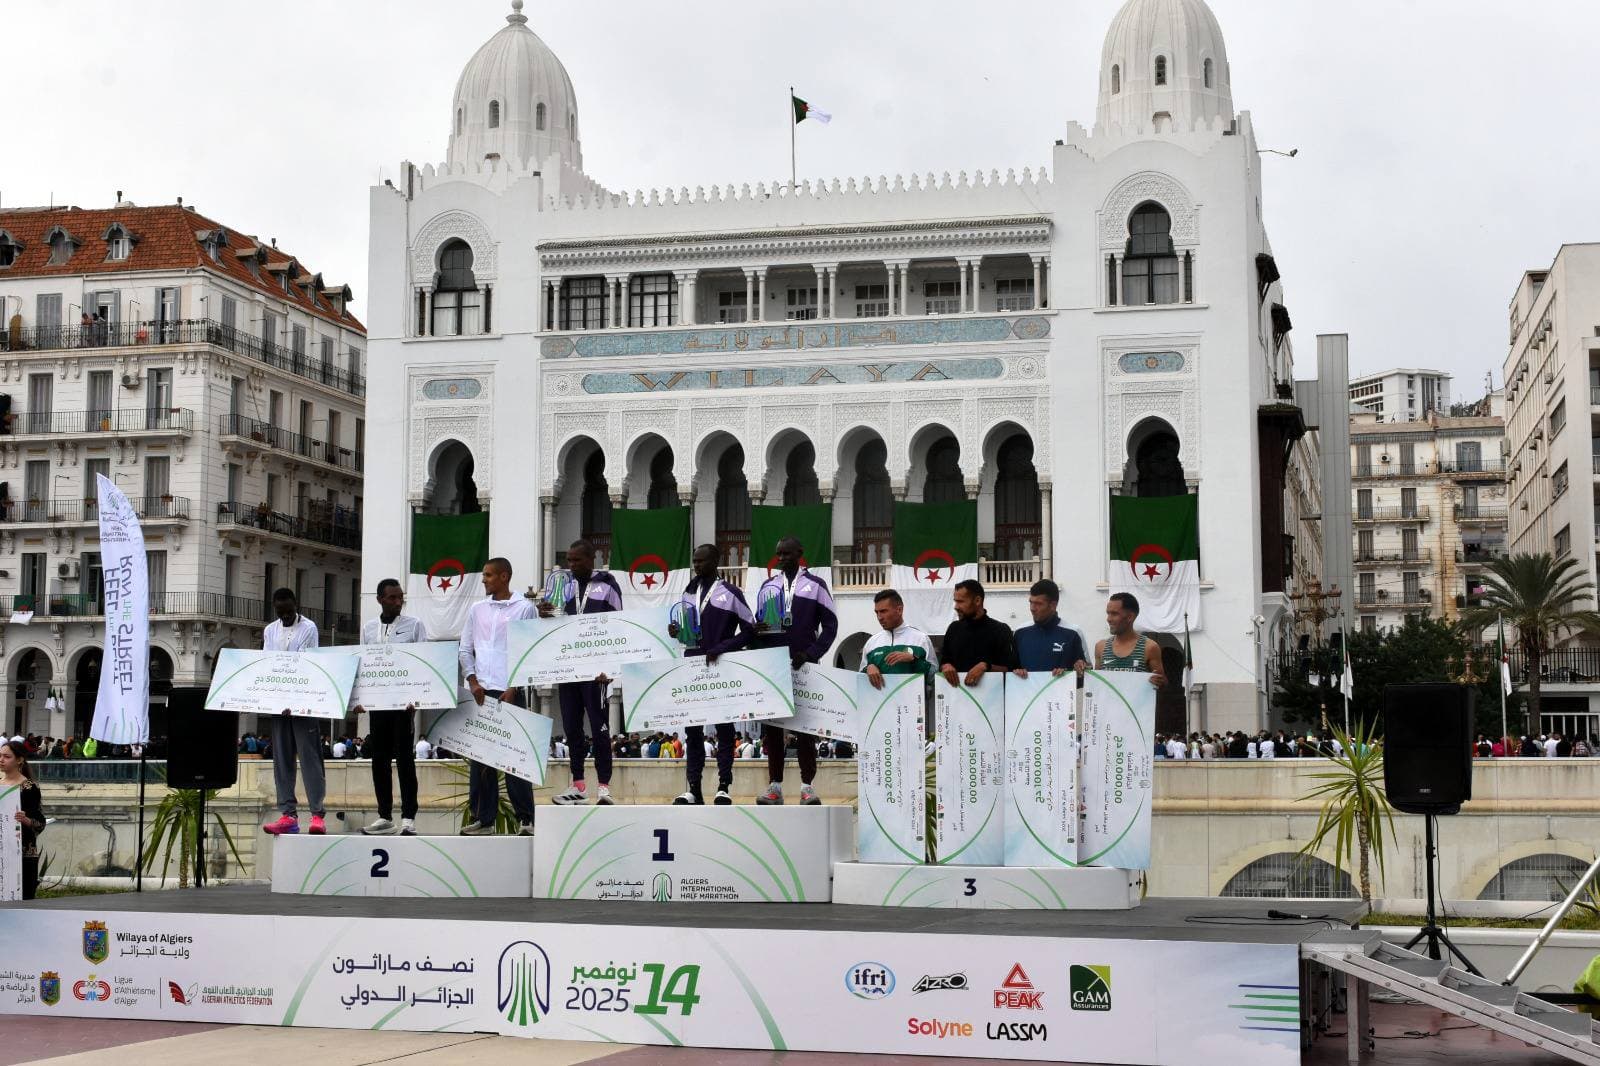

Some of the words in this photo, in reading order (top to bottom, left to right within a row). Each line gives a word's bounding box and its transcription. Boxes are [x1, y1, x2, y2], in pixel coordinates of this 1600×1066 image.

[630, 363, 953, 389] WILAYA
[652, 829, 675, 861] 1
[371, 848, 389, 877] 2
[964, 878, 977, 896] 3
[116, 932, 148, 944] Wilaya
[149, 932, 158, 943] of
[160, 933, 193, 944] Algiers
[332, 954, 411, 974] ماراثون
[416, 957, 474, 974] نصف
[571, 960, 637, 984] نوفمبر
[114, 976, 133, 985] Ligue
[854, 968, 887, 987] ifri
[340, 984, 406, 1010] الدولي
[411, 987, 474, 1009] الجزائر
[566, 986, 630, 1012] 2025
[633, 963, 701, 1016] 14
[1072, 990, 1109, 1003] GAM
[114, 997, 138, 1006] d'Alger
[202, 995, 222, 1004] ALGERIAN
[223, 996, 246, 1005] ATHLETICS
[246, 997, 273, 1006] FEDERATION
[993, 990, 1045, 1010] PEAK
[908, 1017, 973, 1039] Solyne
[986, 1022, 1047, 1041] LASSM
